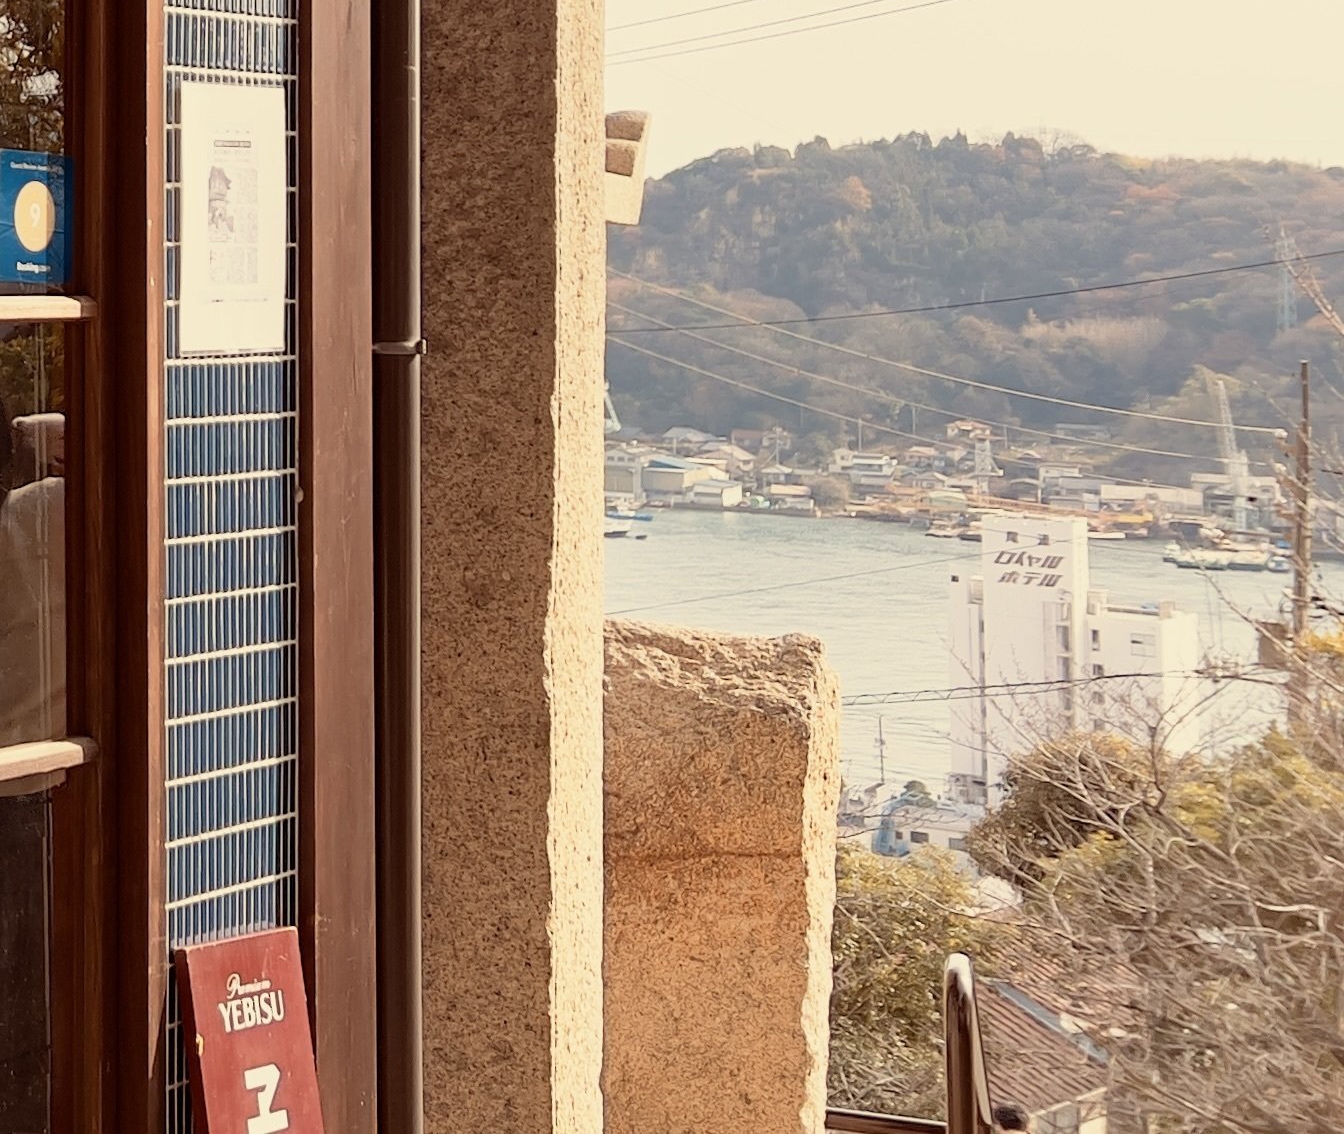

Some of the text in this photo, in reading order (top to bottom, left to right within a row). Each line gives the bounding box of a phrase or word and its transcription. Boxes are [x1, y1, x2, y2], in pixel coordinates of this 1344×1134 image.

[994, 550, 1064, 569] ロイヤル
[998, 571, 1064, 587] ホテル
[217, 989, 285, 1034] YEBISU
